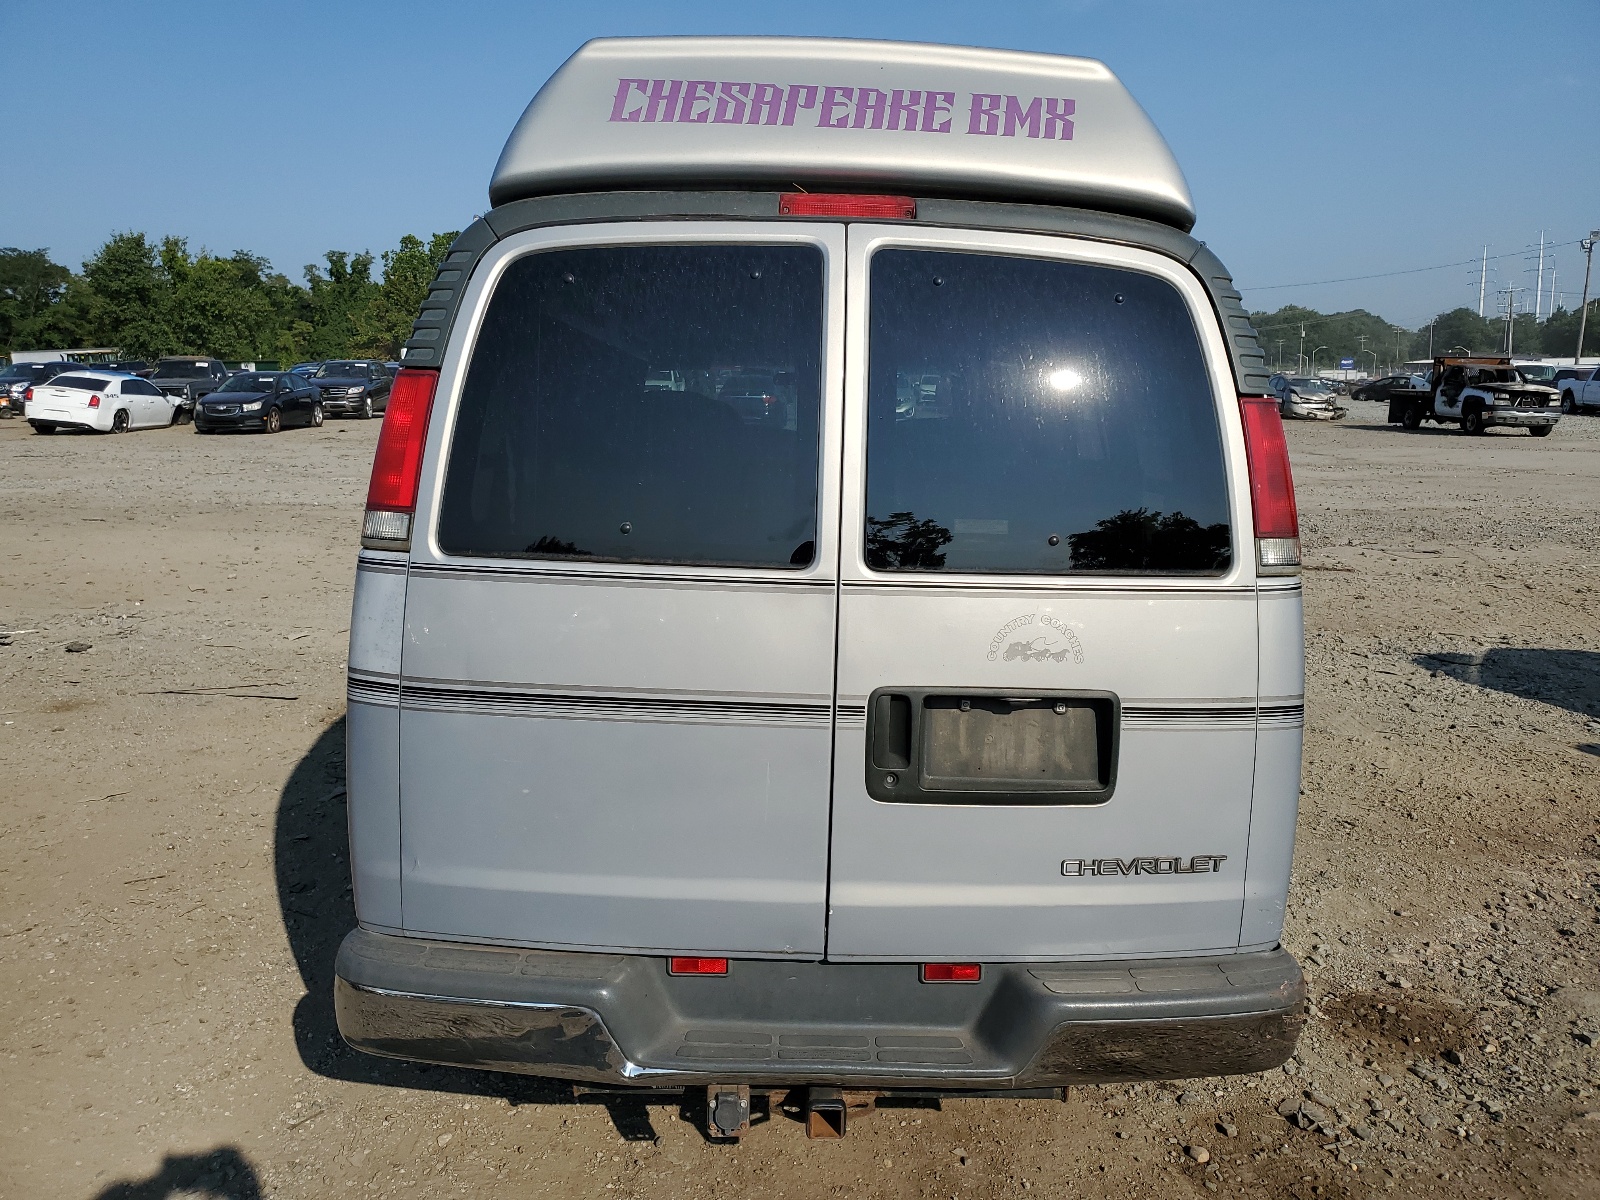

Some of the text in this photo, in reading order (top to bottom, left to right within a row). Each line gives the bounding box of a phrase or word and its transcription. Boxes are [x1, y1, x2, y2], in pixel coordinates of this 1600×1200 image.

[607, 78, 1076, 141] CHESAPEAKE BMX
[986, 613, 1085, 665] COUNTRY COACHES
[1060, 855, 1227, 877] CHEVROLET
